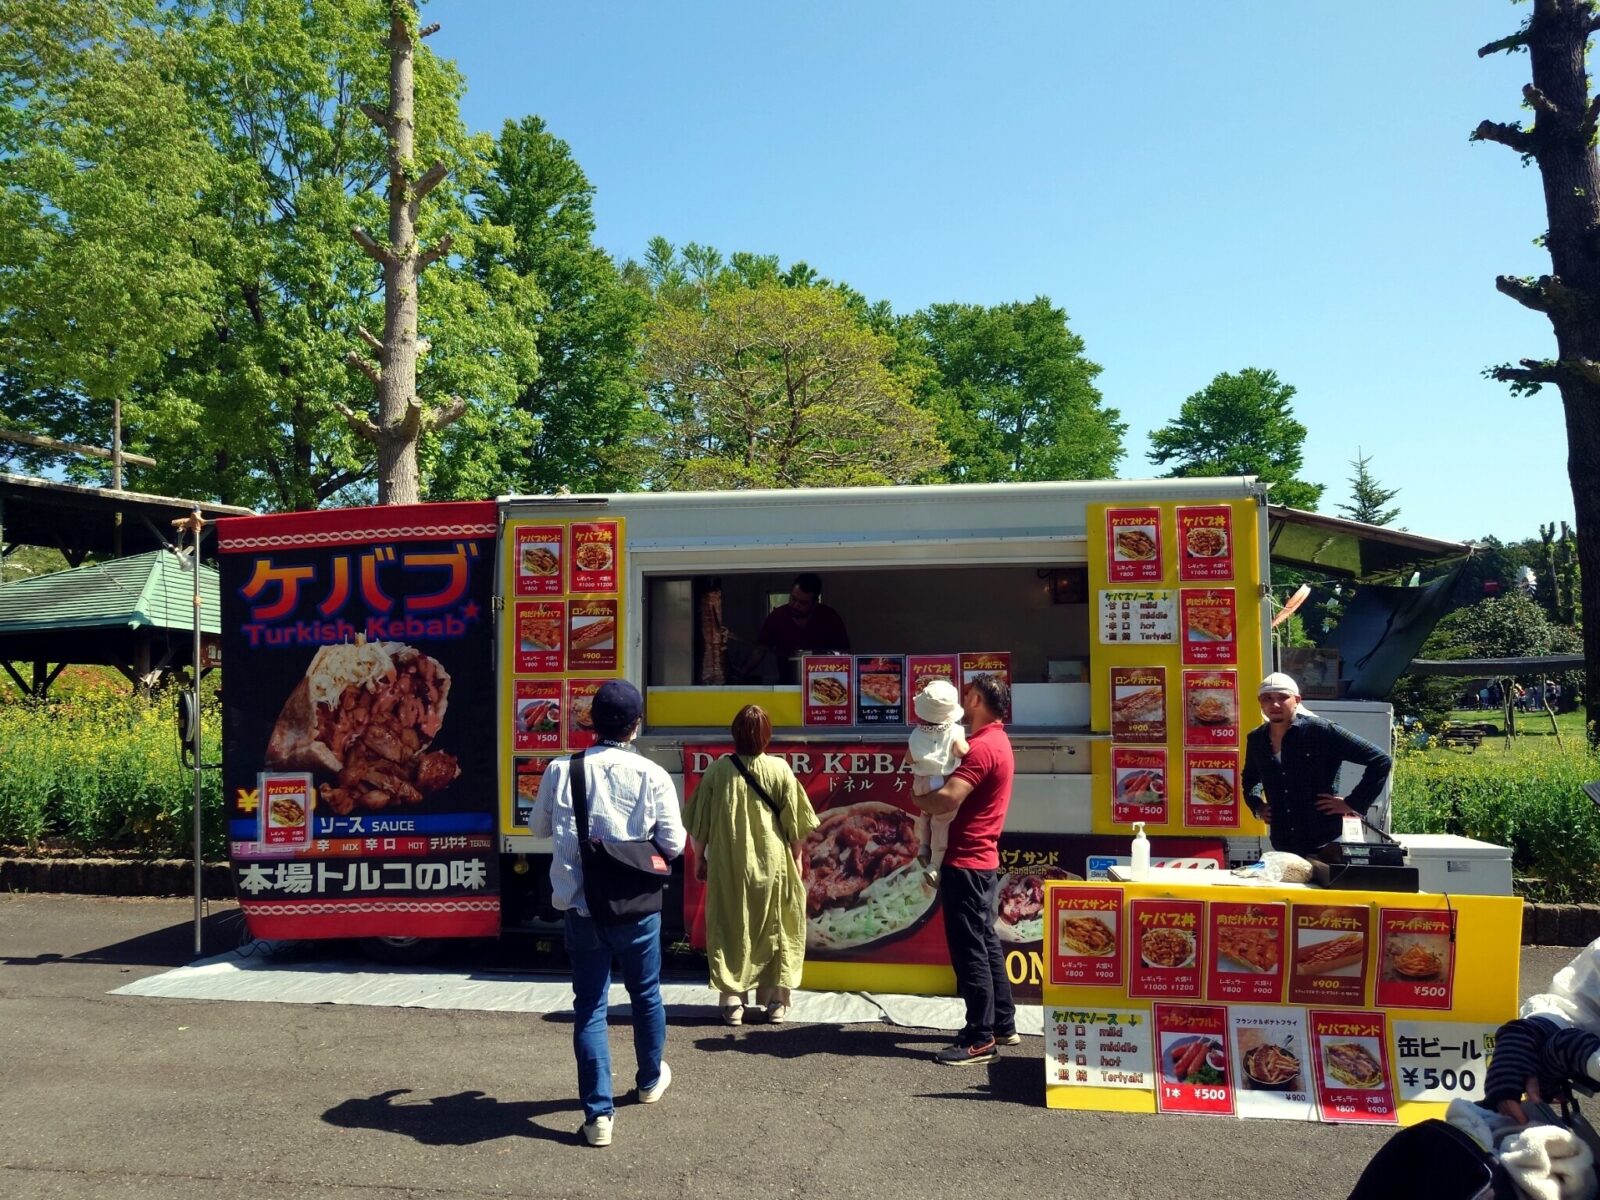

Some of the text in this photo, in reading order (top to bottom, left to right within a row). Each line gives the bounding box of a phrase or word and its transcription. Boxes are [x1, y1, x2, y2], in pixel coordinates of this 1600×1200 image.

[1112, 517, 1157, 526] ケバブサンド
[1184, 516, 1226, 527] ケバブ丼
[520, 535, 561, 543] ケバブサンド
[242, 543, 479, 621] ケバブ
[1105, 592, 1154, 601] ケバブソース
[1140, 602, 1158, 610] mild
[1140, 612, 1168, 620] middle
[243, 612, 465, 645] Turkish Kebab
[1140, 622, 1156, 630] hot
[1140, 632, 1171, 642] Teriyaki
[808, 663, 849, 672] ケバブサンド
[1115, 676, 1161, 685] ロングポテト
[1128, 724, 1148, 732] ¥900
[1211, 729, 1234, 737] ¥500
[1189, 760, 1235, 768] ケバブサンド
[829, 776, 874, 793] ドネル
[1140, 806, 1162, 814] ¥500
[320, 817, 414, 834] ソース SAUCE
[342, 843, 359, 851] MIX
[365, 838, 396, 850] 辛口
[408, 842, 424, 850] HOT
[430, 836, 468, 850] テリヤキ
[238, 858, 487, 895] 本場トルコの味
[1009, 866, 1047, 876] Sandwich
[1057, 899, 1118, 910] ケバブサンド
[1139, 912, 1196, 927] ケバブ丼
[1216, 914, 1279, 926] 肉だけケバブ
[1298, 917, 1362, 929] ロングポテト
[1387, 920, 1449, 931] フライドポテト
[1313, 980, 1340, 989] ¥900
[1413, 986, 1446, 997] ¥500
[1052, 1010, 1118, 1026] ケバブソース
[1161, 1015, 1222, 1028] フランクフルト
[1099, 1027, 1123, 1038] mild
[1318, 1023, 1380, 1036] ケバブサンド
[1100, 1042, 1138, 1053] middle
[1398, 1035, 1482, 1060] 缶ビール
[1101, 1056, 1121, 1067] hot
[1101, 1071, 1143, 1084] Teriyaki
[1402, 1067, 1476, 1092] ¥500
[1165, 1088, 1226, 1100] 1本 ¥500
[1285, 1093, 1306, 1101] ¥900
[1336, 1105, 1387, 1114] ¥800 ¥900
